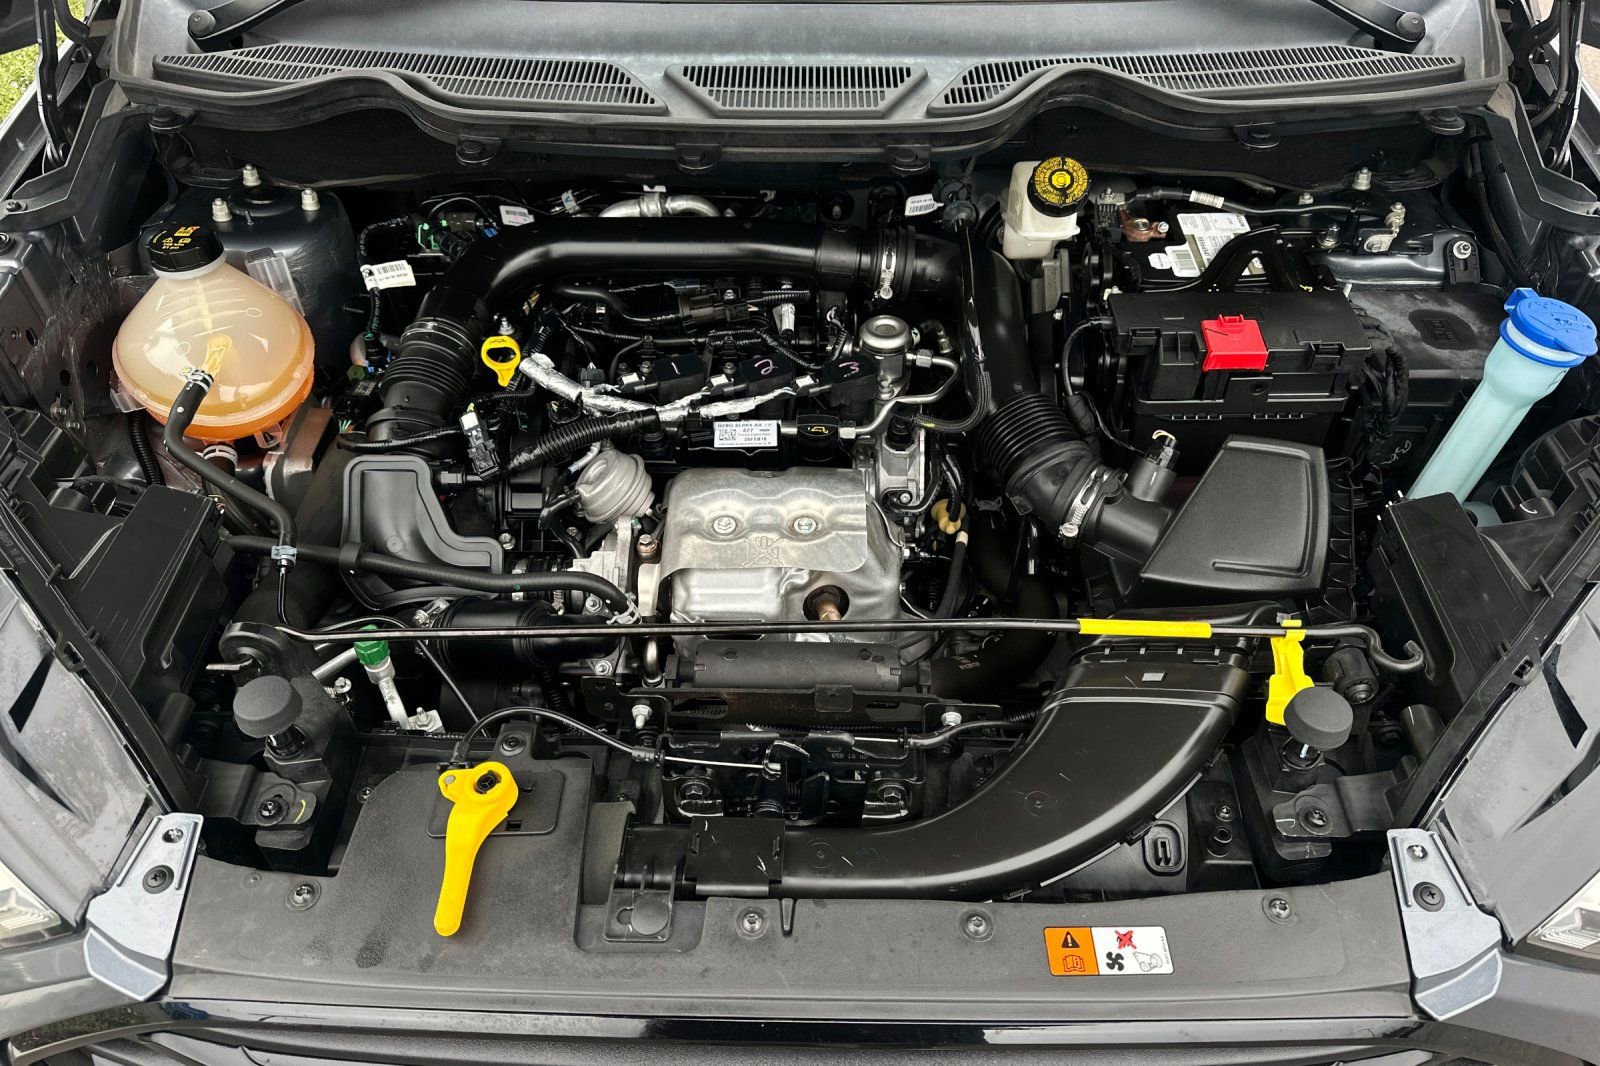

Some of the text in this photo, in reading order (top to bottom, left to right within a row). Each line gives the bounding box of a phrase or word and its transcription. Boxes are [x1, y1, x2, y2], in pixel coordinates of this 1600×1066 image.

[671, 362, 680, 375] 1
[754, 358, 777, 375] 2
[839, 361, 860, 376] 3
